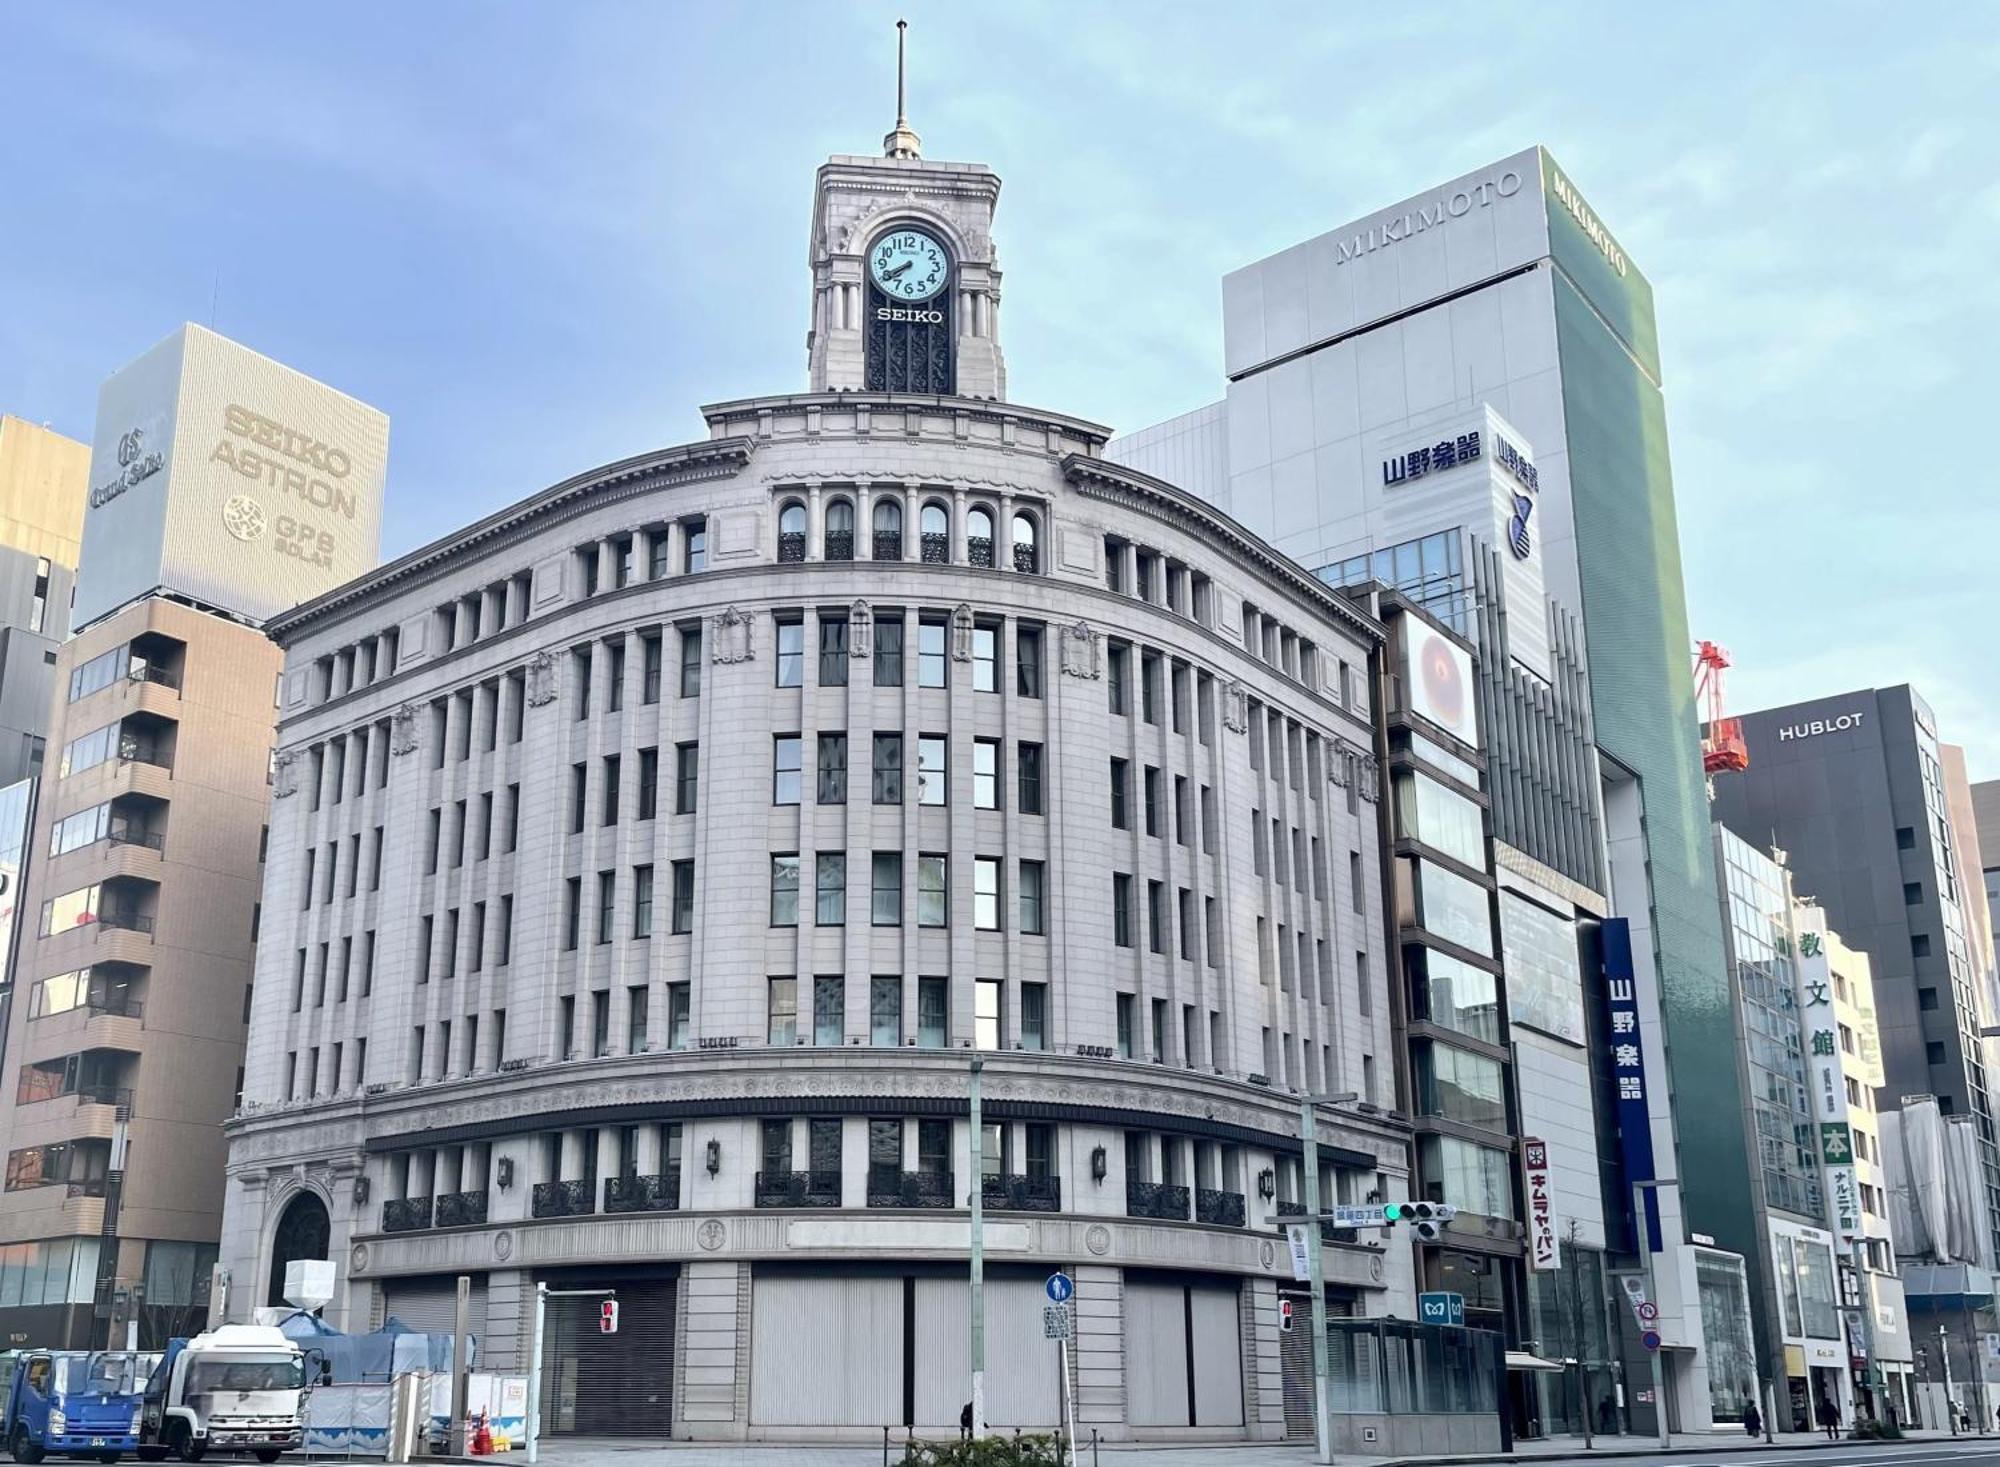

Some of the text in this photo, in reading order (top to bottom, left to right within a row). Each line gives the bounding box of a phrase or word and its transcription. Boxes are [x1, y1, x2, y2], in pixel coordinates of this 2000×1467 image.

[1336, 172, 1522, 265] MIKIMOTO
[1553, 171, 1626, 277] MIKIMOTO
[882, 247, 893, 258] 10
[892, 238, 901, 250] 11
[904, 236, 915, 248] 12
[920, 241, 925, 252] 1
[878, 258, 887, 269] 9
[928, 249, 936, 260] 2
[932, 261, 940, 273] 3
[893, 279, 902, 290] 7
[904, 283, 913, 294] 6
[917, 281, 926, 292] 5
[927, 273, 936, 284] 4
[877, 308, 942, 323] SEIKO
[224, 403, 351, 479] SEIKO
[1383, 431, 1481, 485] 山野楽器
[209, 440, 356, 520] ASTRON
[275, 515, 335, 553] GPS
[274, 538, 333, 570] SOLAR
[1779, 712, 1864, 741] HUBLOT
[1799, 931, 1835, 1057] 教文館
[1609, 979, 1642, 1099] 山野楽器
[1825, 1129, 1850, 1158] 本
[1531, 1174, 1554, 1263] キムラヤのパン
